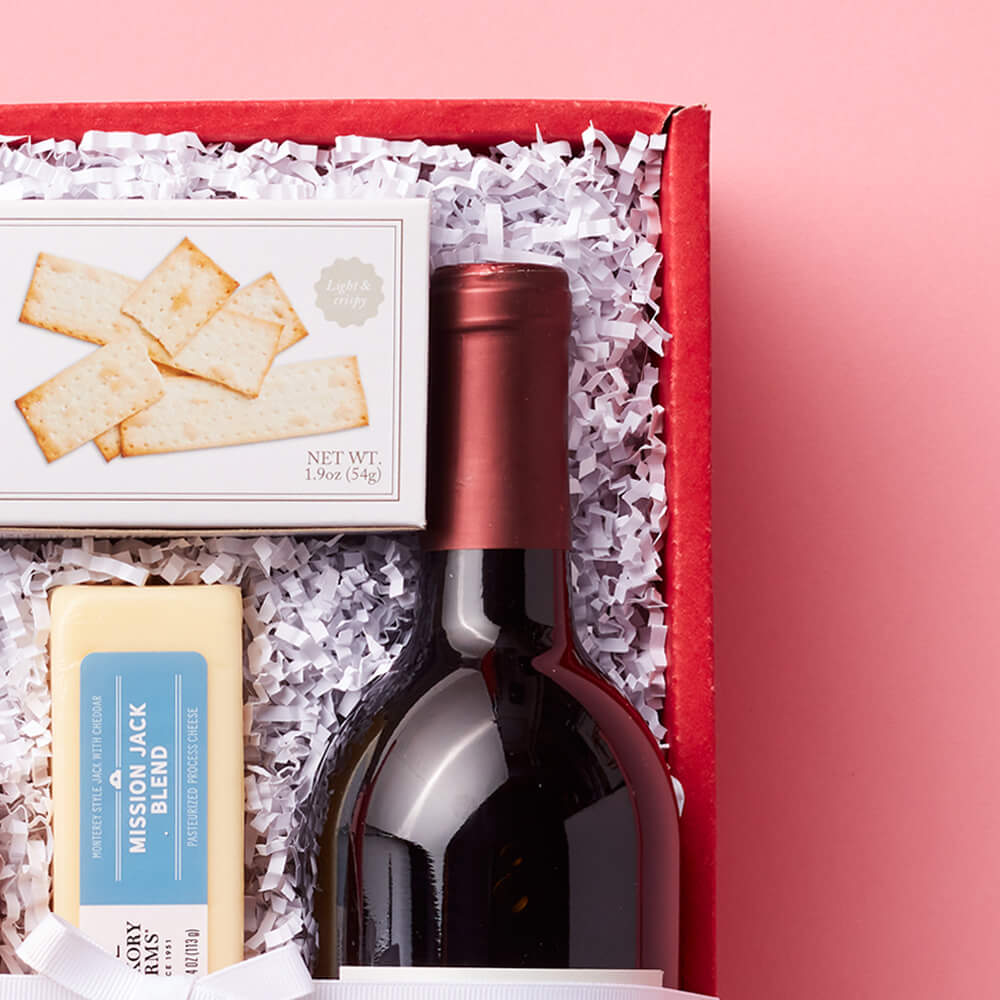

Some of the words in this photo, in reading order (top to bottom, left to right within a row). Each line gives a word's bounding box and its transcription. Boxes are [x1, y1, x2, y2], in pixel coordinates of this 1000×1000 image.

[326, 279, 358, 293] Light
[360, 281, 371, 292] &
[333, 295, 367, 309] crispy
[307, 451, 344, 465] NET
[348, 451, 382, 465] WT.
[305, 468, 341, 481] 1.9oz
[345, 467, 382, 485] (54g)
[91, 695, 102, 735] CHEDDAR
[129, 702, 147, 757] JACK
[187, 707, 199, 742] CHEESE
[91, 737, 102, 760] WITH
[187, 744, 199, 784] PROCESS
[91, 762, 102, 784] JACK
[151, 745, 168, 815] BLEND
[91, 786, 102, 813] STYLE
[129, 764, 147, 854] MISSION
[187, 787, 199, 847] PASTEURIZED
[91, 815, 102, 859] MONTEREY
[144, 933, 159, 976] RMS
[185, 957, 198, 968] OZ
